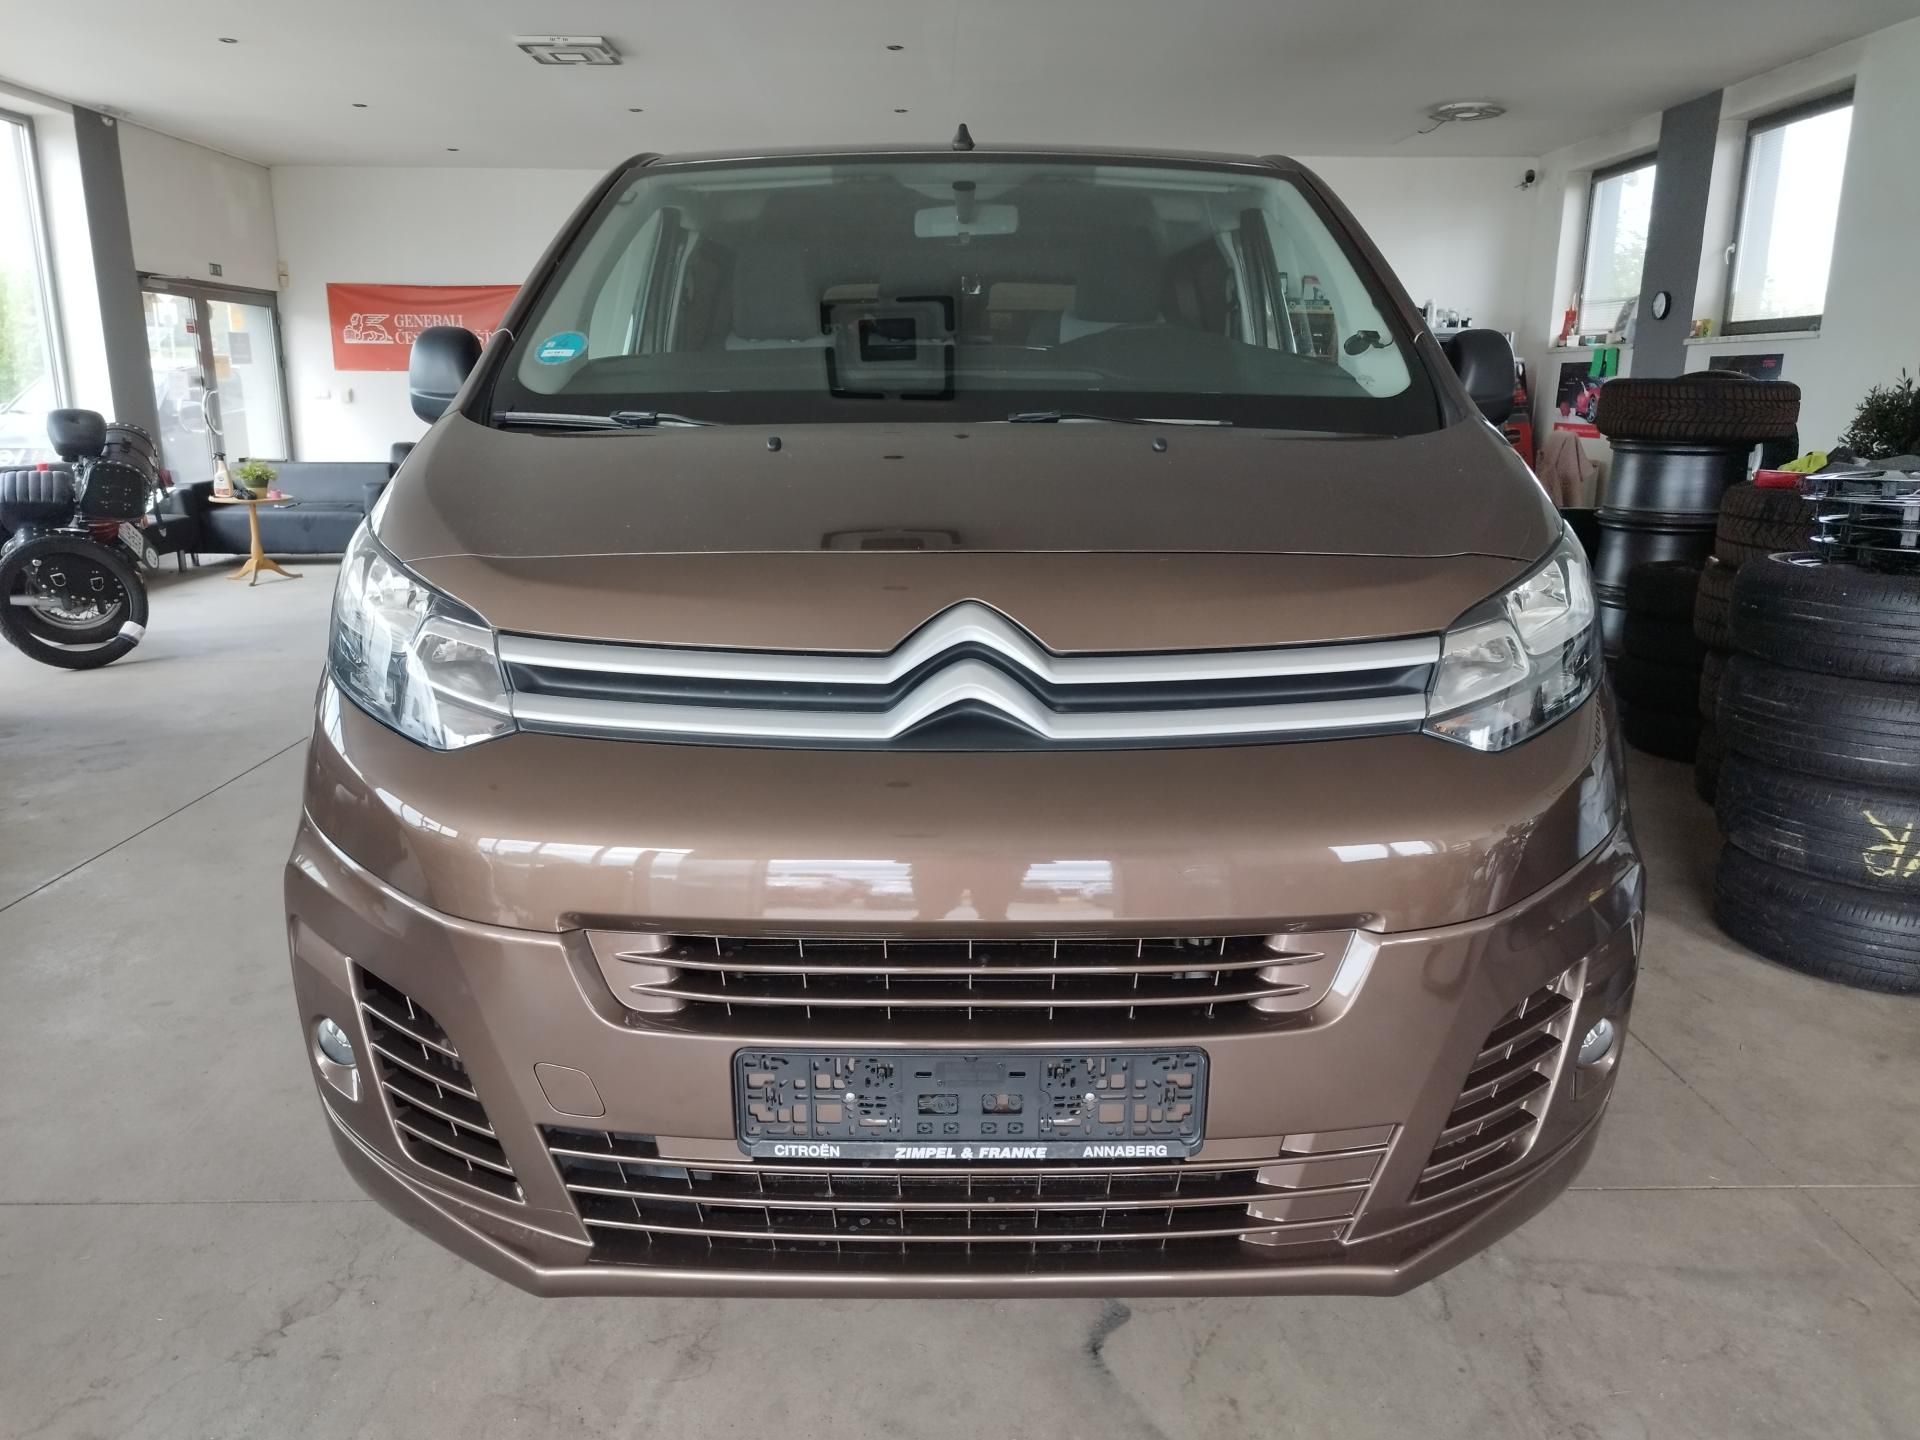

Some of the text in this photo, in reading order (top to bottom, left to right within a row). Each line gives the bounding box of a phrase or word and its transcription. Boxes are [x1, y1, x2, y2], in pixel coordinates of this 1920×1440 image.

[394, 314, 464, 328] GENERALI
[774, 1144, 1168, 1159] CITROËN ZIMPEL & FRANKE ANNABERG
